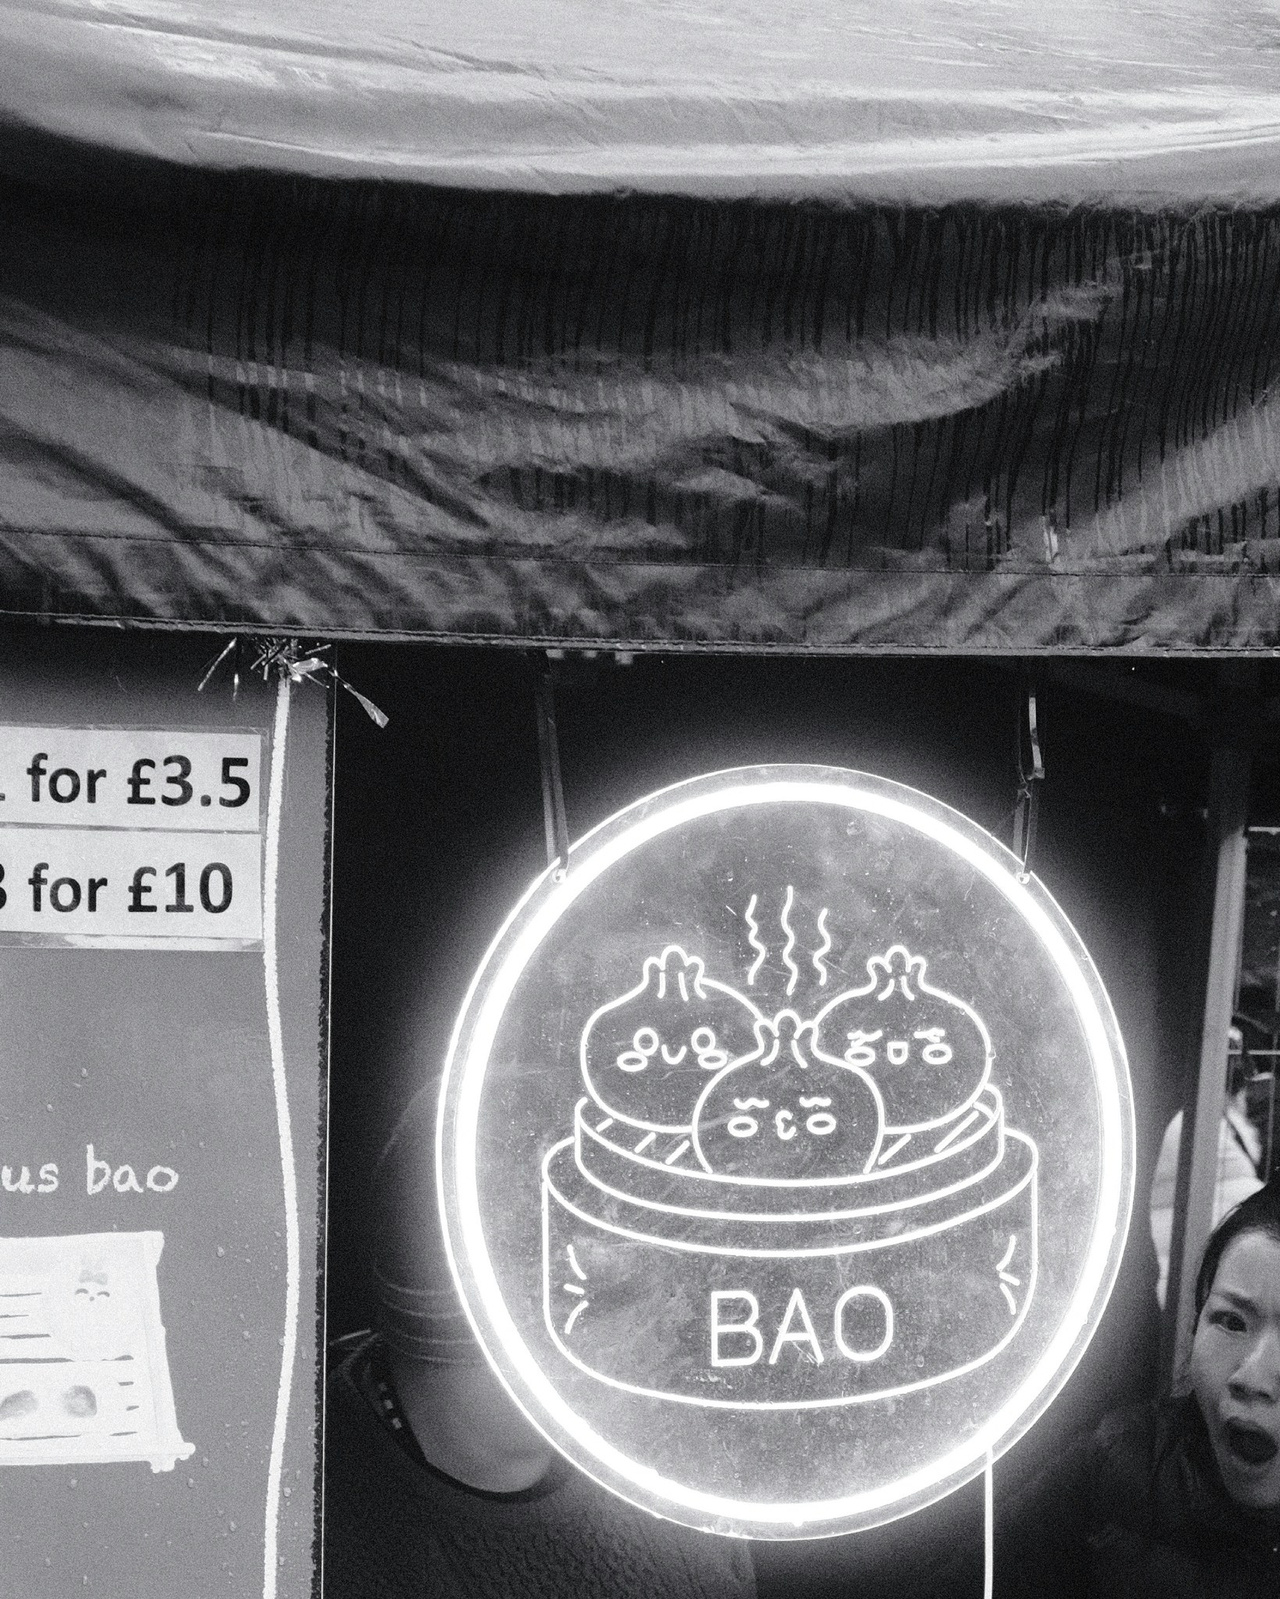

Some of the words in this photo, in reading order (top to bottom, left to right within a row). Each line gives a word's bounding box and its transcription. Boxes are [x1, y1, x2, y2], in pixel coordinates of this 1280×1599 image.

[26, 753, 107, 803] for
[127, 755, 251, 808] £3.5
[28, 862, 108, 912] for
[127, 862, 234, 914] £10
[86, 1143, 180, 1195] bao
[710, 1285, 894, 1367] BAO
